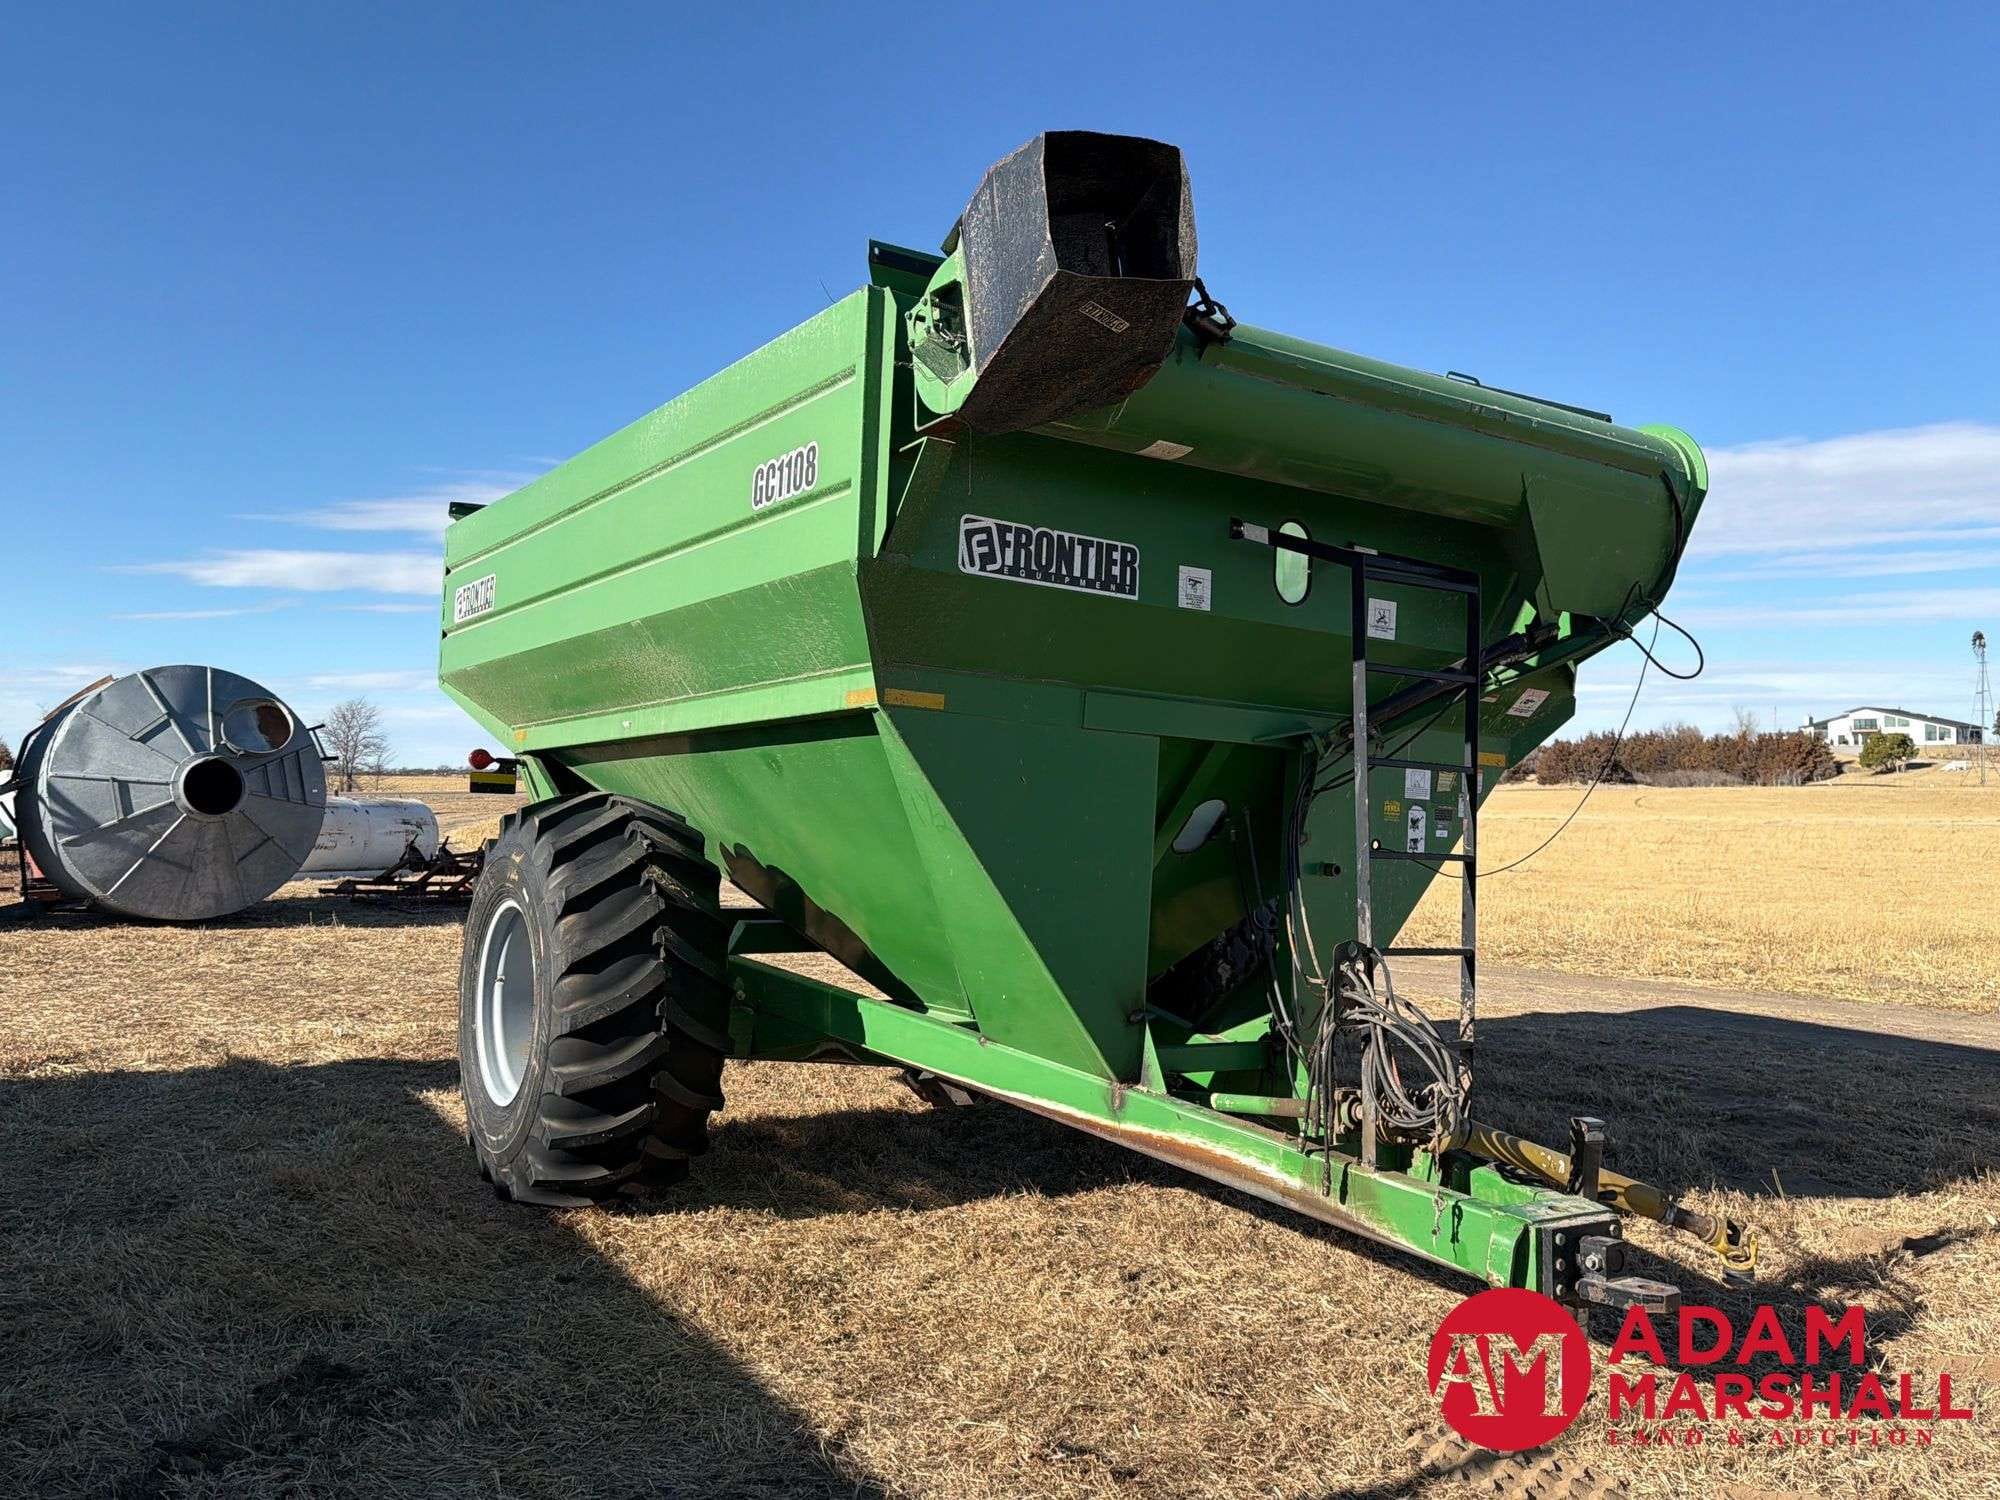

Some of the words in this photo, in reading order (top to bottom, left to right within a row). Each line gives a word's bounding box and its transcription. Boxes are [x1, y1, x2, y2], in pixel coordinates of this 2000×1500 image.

[753, 444, 817, 508] GC1108
[998, 523, 1138, 586] FRONTIER
[1003, 566, 1130, 593] EQUIPMENT
